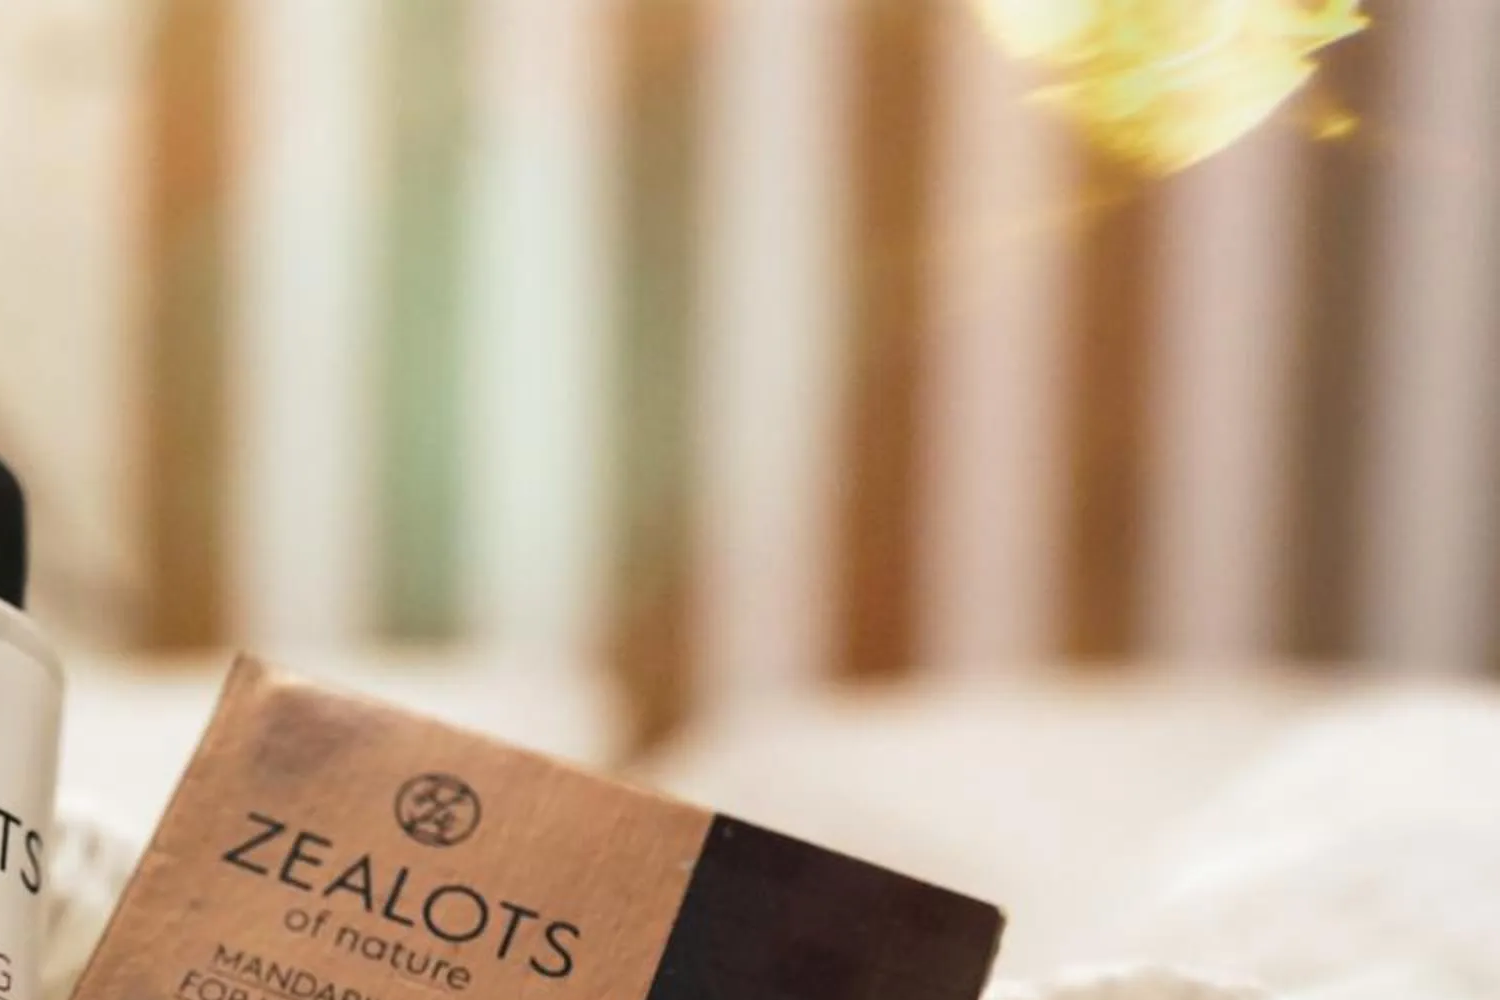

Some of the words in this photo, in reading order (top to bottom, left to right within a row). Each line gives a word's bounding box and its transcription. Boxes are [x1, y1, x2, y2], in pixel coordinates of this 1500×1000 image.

[221, 811, 582, 979] ZEALOTS
[283, 905, 332, 938] of
[335, 919, 473, 991] nature
